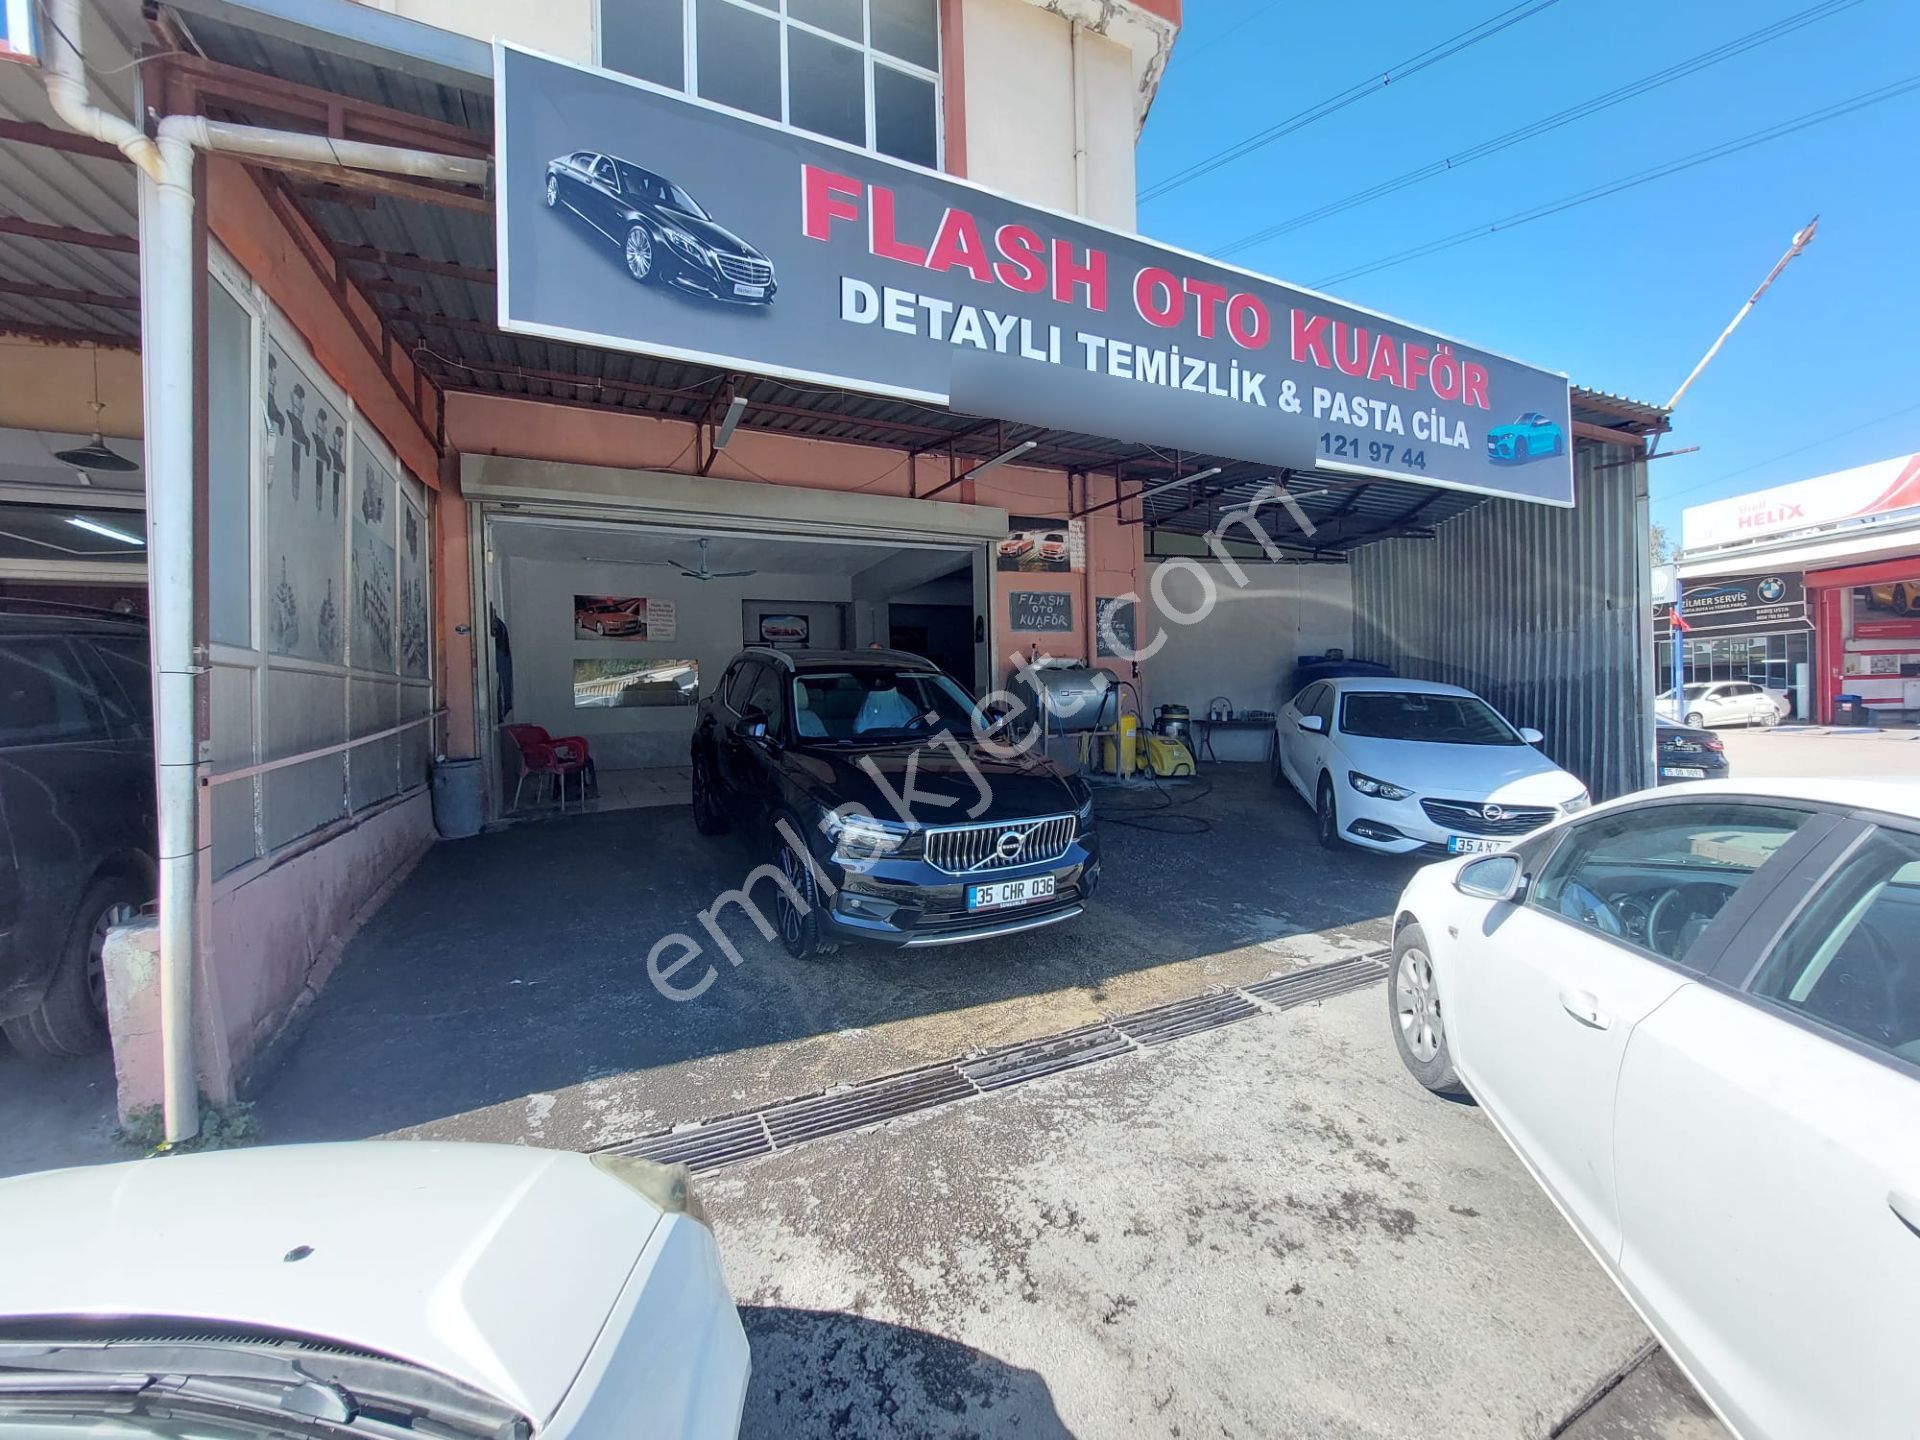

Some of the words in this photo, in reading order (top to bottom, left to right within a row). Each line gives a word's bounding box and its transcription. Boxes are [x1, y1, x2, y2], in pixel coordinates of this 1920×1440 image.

[801, 163, 1107, 312] FLASH
[1133, 266, 1271, 351] OTO
[1291, 309, 1491, 410] KUAFÖR
[840, 276, 1061, 364] DETAYLI
[1077, 331, 1267, 407] TEMİZLİK
[1279, 380, 1302, 415] &
[1313, 386, 1405, 436] PASTA
[1412, 407, 1471, 450] CİLA
[1320, 431, 1359, 459] 121
[1368, 441, 1395, 464] 97
[1401, 448, 1427, 470] 44
[1019, 594, 1065, 606] FLASH
[1714, 592, 1747, 605] SERVİS
[1032, 605, 1053, 614] OTO
[1019, 613, 1068, 626] KUAFÖR
[1458, 839, 1474, 852] 35
[977, 887, 993, 905] 35
[1002, 882, 1024, 901] CHR
[1032, 878, 1053, 896] 036
